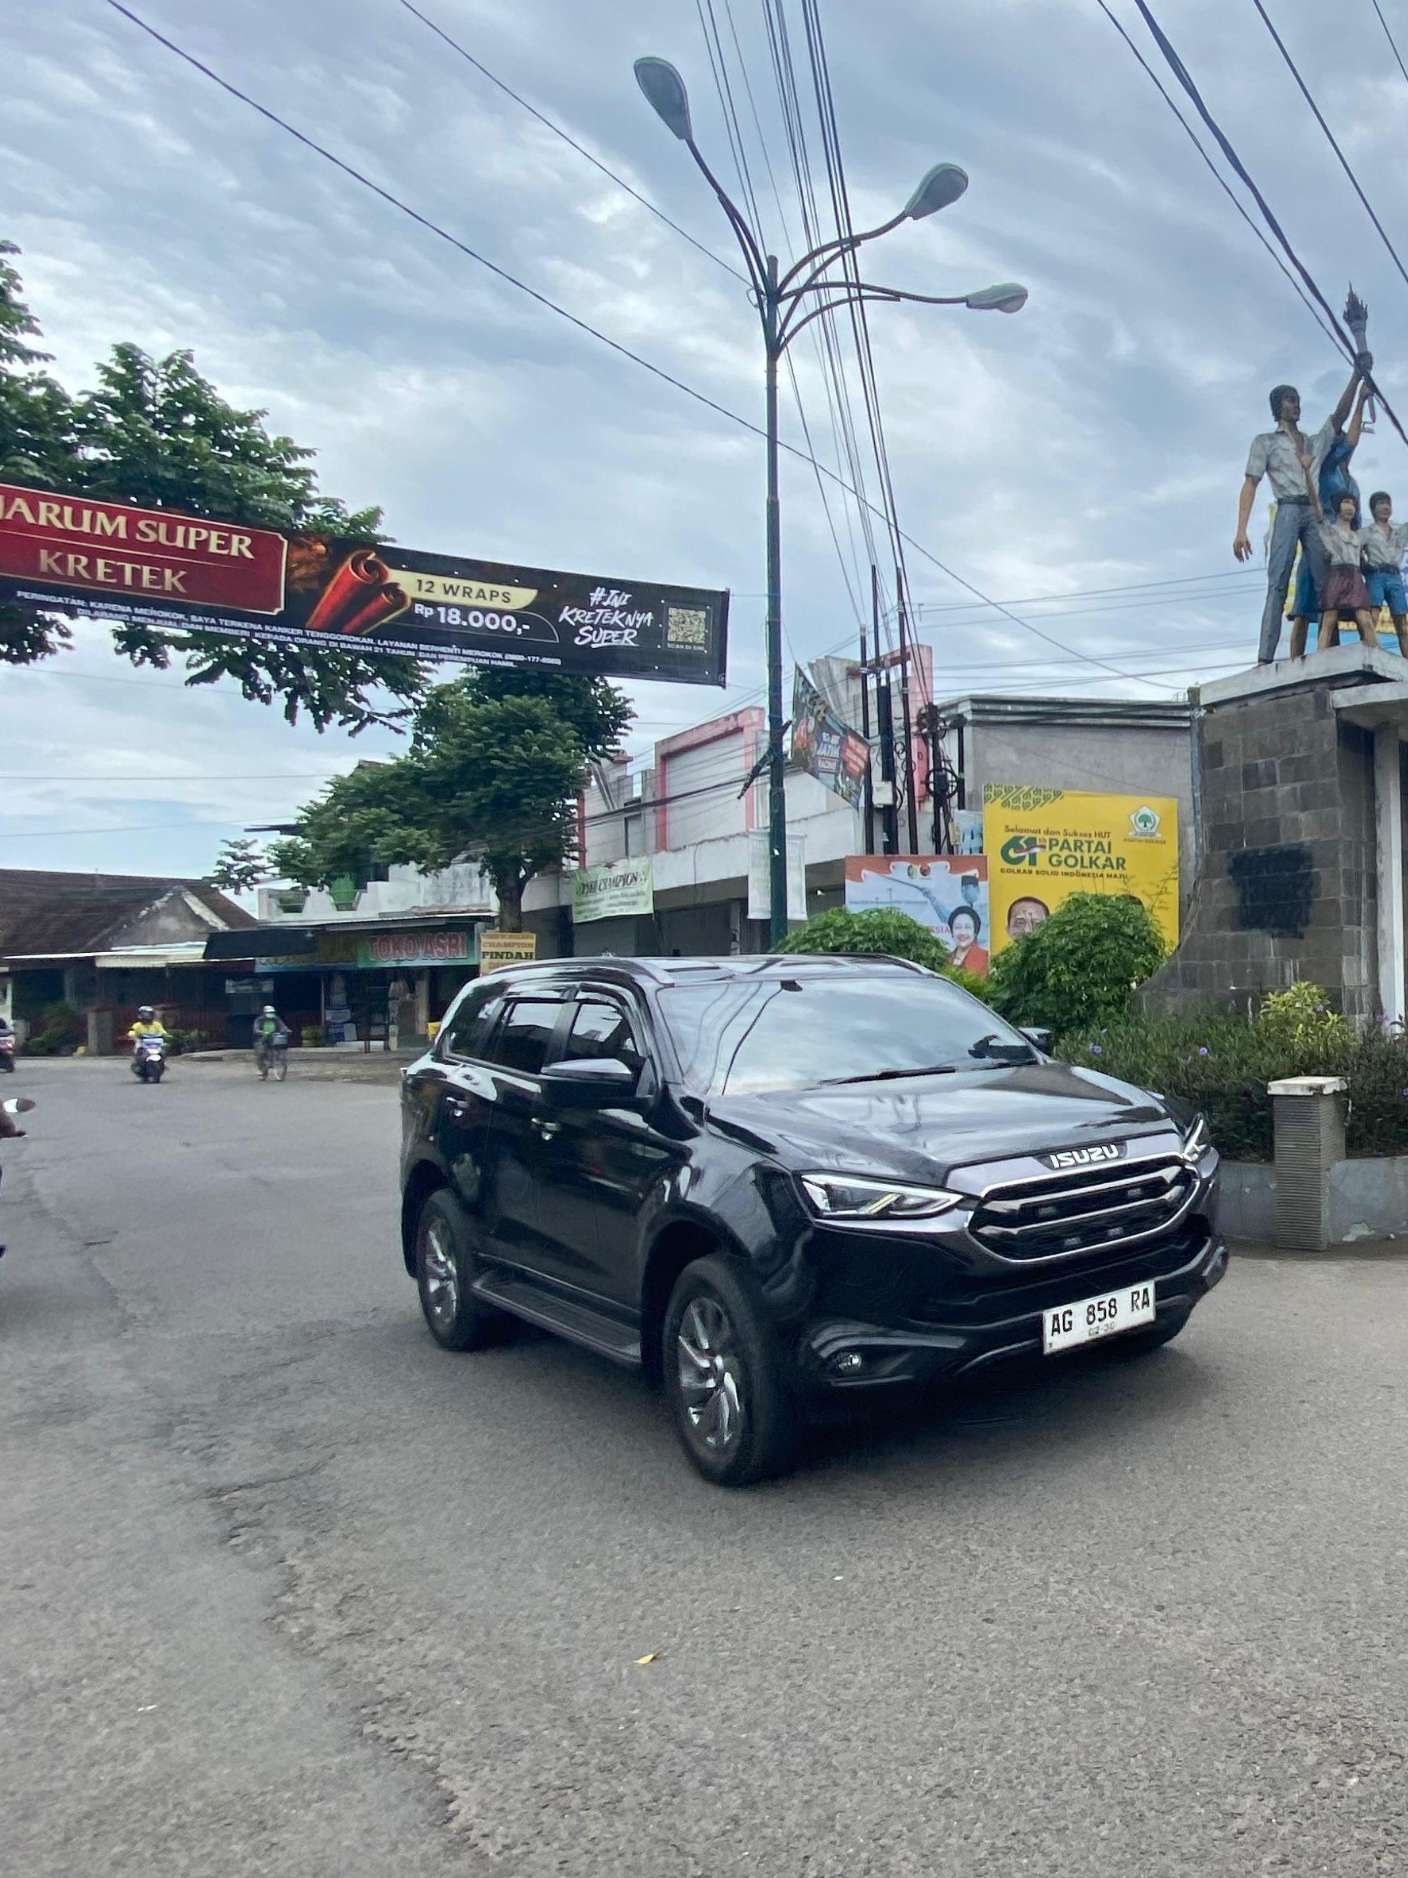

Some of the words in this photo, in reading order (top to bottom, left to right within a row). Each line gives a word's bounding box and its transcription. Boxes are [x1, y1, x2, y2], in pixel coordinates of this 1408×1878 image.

[135, 520, 255, 560] SUPER
[39, 549, 188, 593] KRETEK
[416, 579, 435, 592] 12
[442, 583, 511, 603] WRAPS
[589, 587, 632, 608] #INI
[414, 603, 434, 618] Rp
[437, 606, 530, 635] 18.000,-
[558, 606, 653, 628] KRETEKNYA
[574, 626, 640, 648] SUPER
[1048, 837, 1112, 854] PARTAI
[1094, 830, 1111, 839] HUT
[1048, 853, 1126, 871] GOLKAR
[1050, 1144, 1119, 1169] ISUZU
[1051, 1309, 1073, 1337] AG
[1086, 1297, 1118, 1326] 858
[1131, 1287, 1150, 1312] RA
